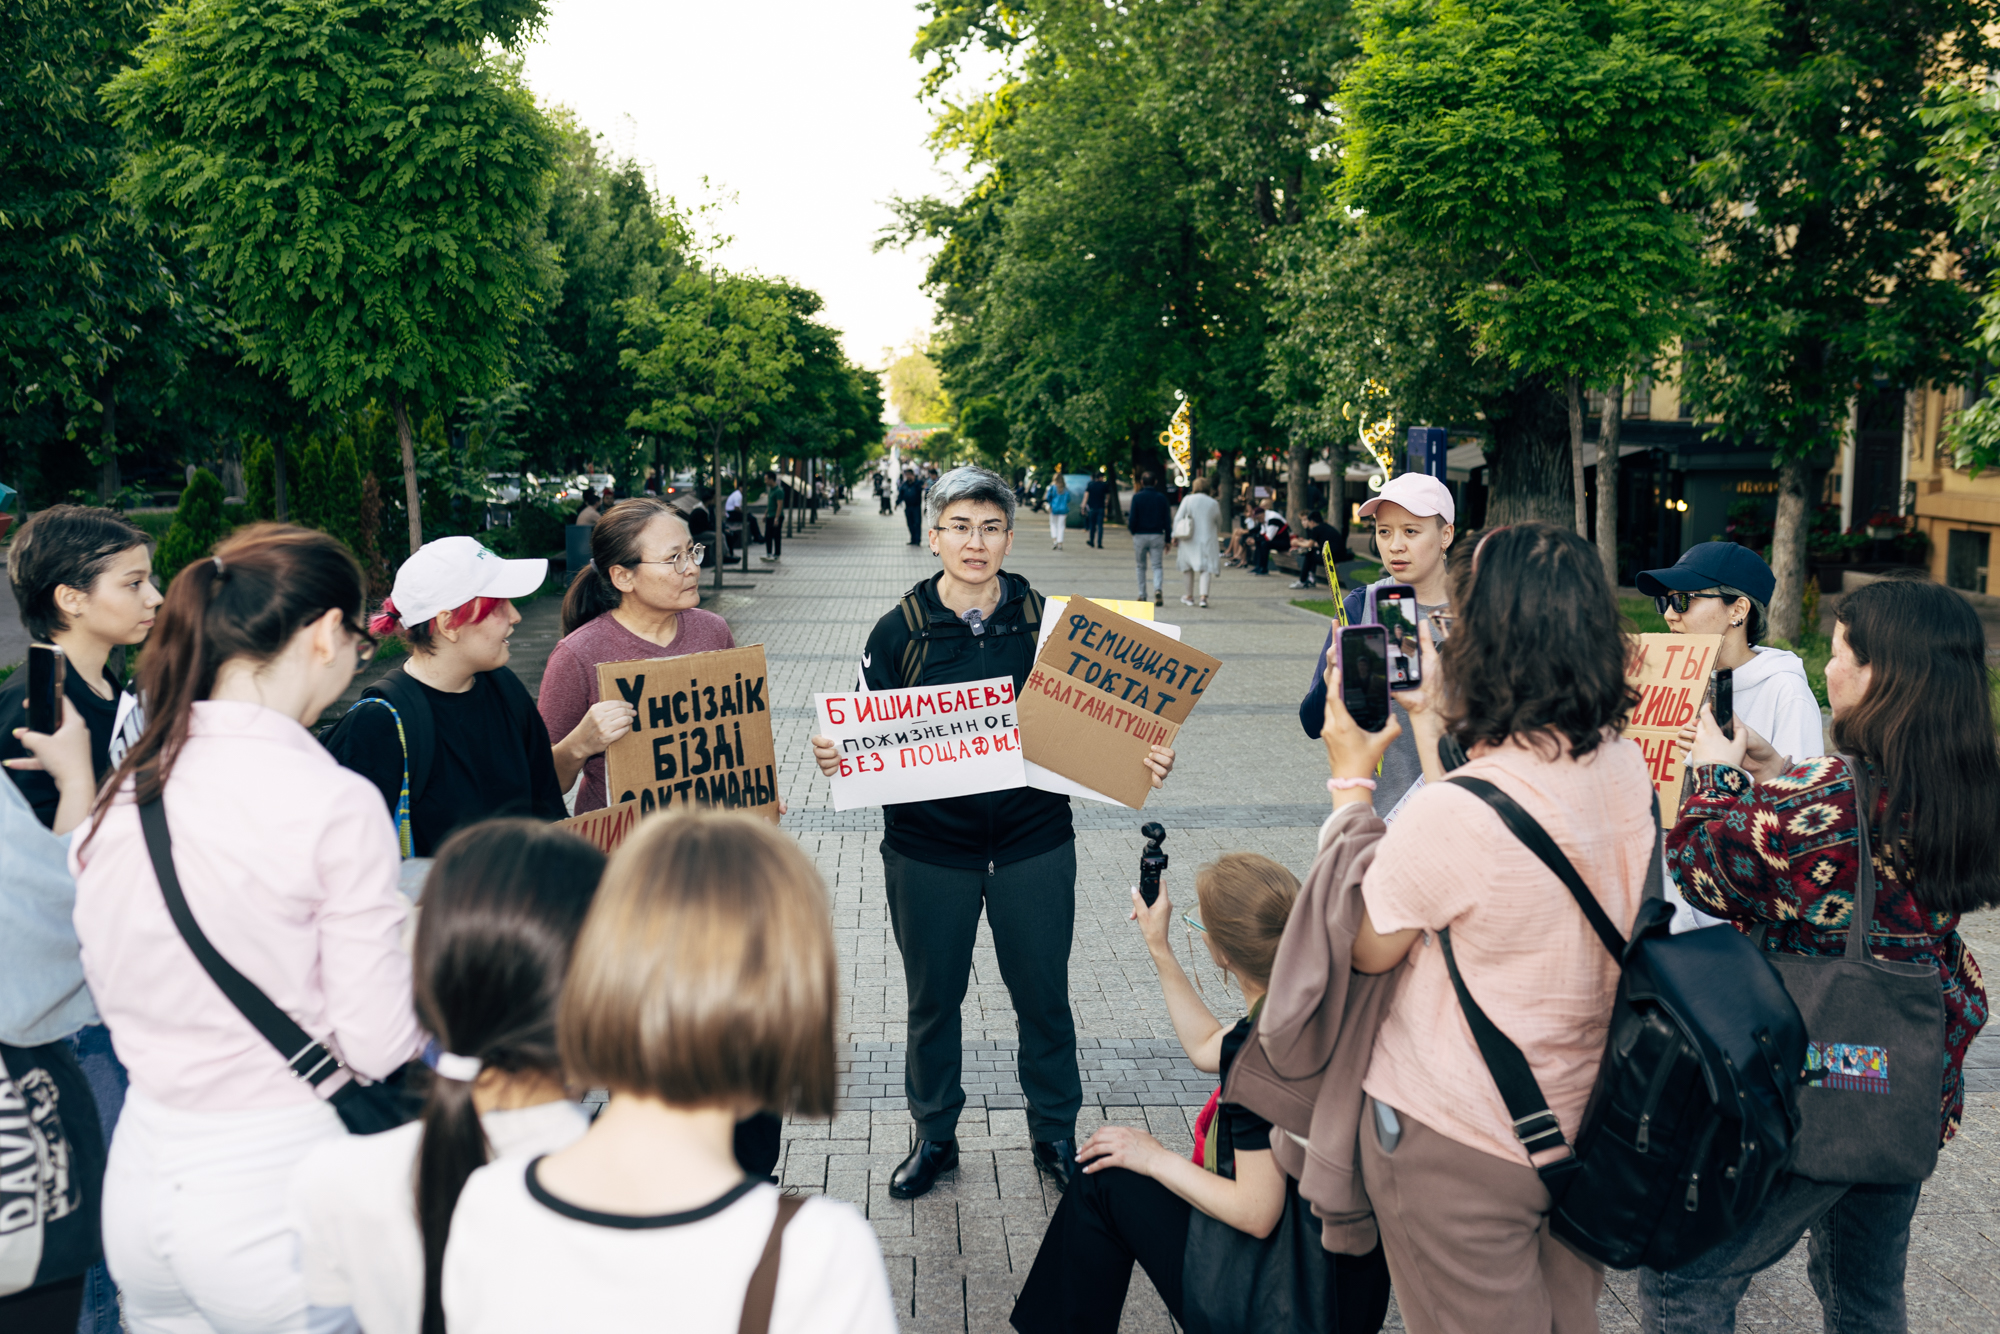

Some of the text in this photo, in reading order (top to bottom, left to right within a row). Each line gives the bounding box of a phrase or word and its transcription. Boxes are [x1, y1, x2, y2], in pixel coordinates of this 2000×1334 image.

[1662, 645, 1710, 680] ТЫ
[826, 683, 1014, 725] БИШИМБАЕВУ
[839, 728, 1020, 777] БЕЗ ПОЩАДЫ!
